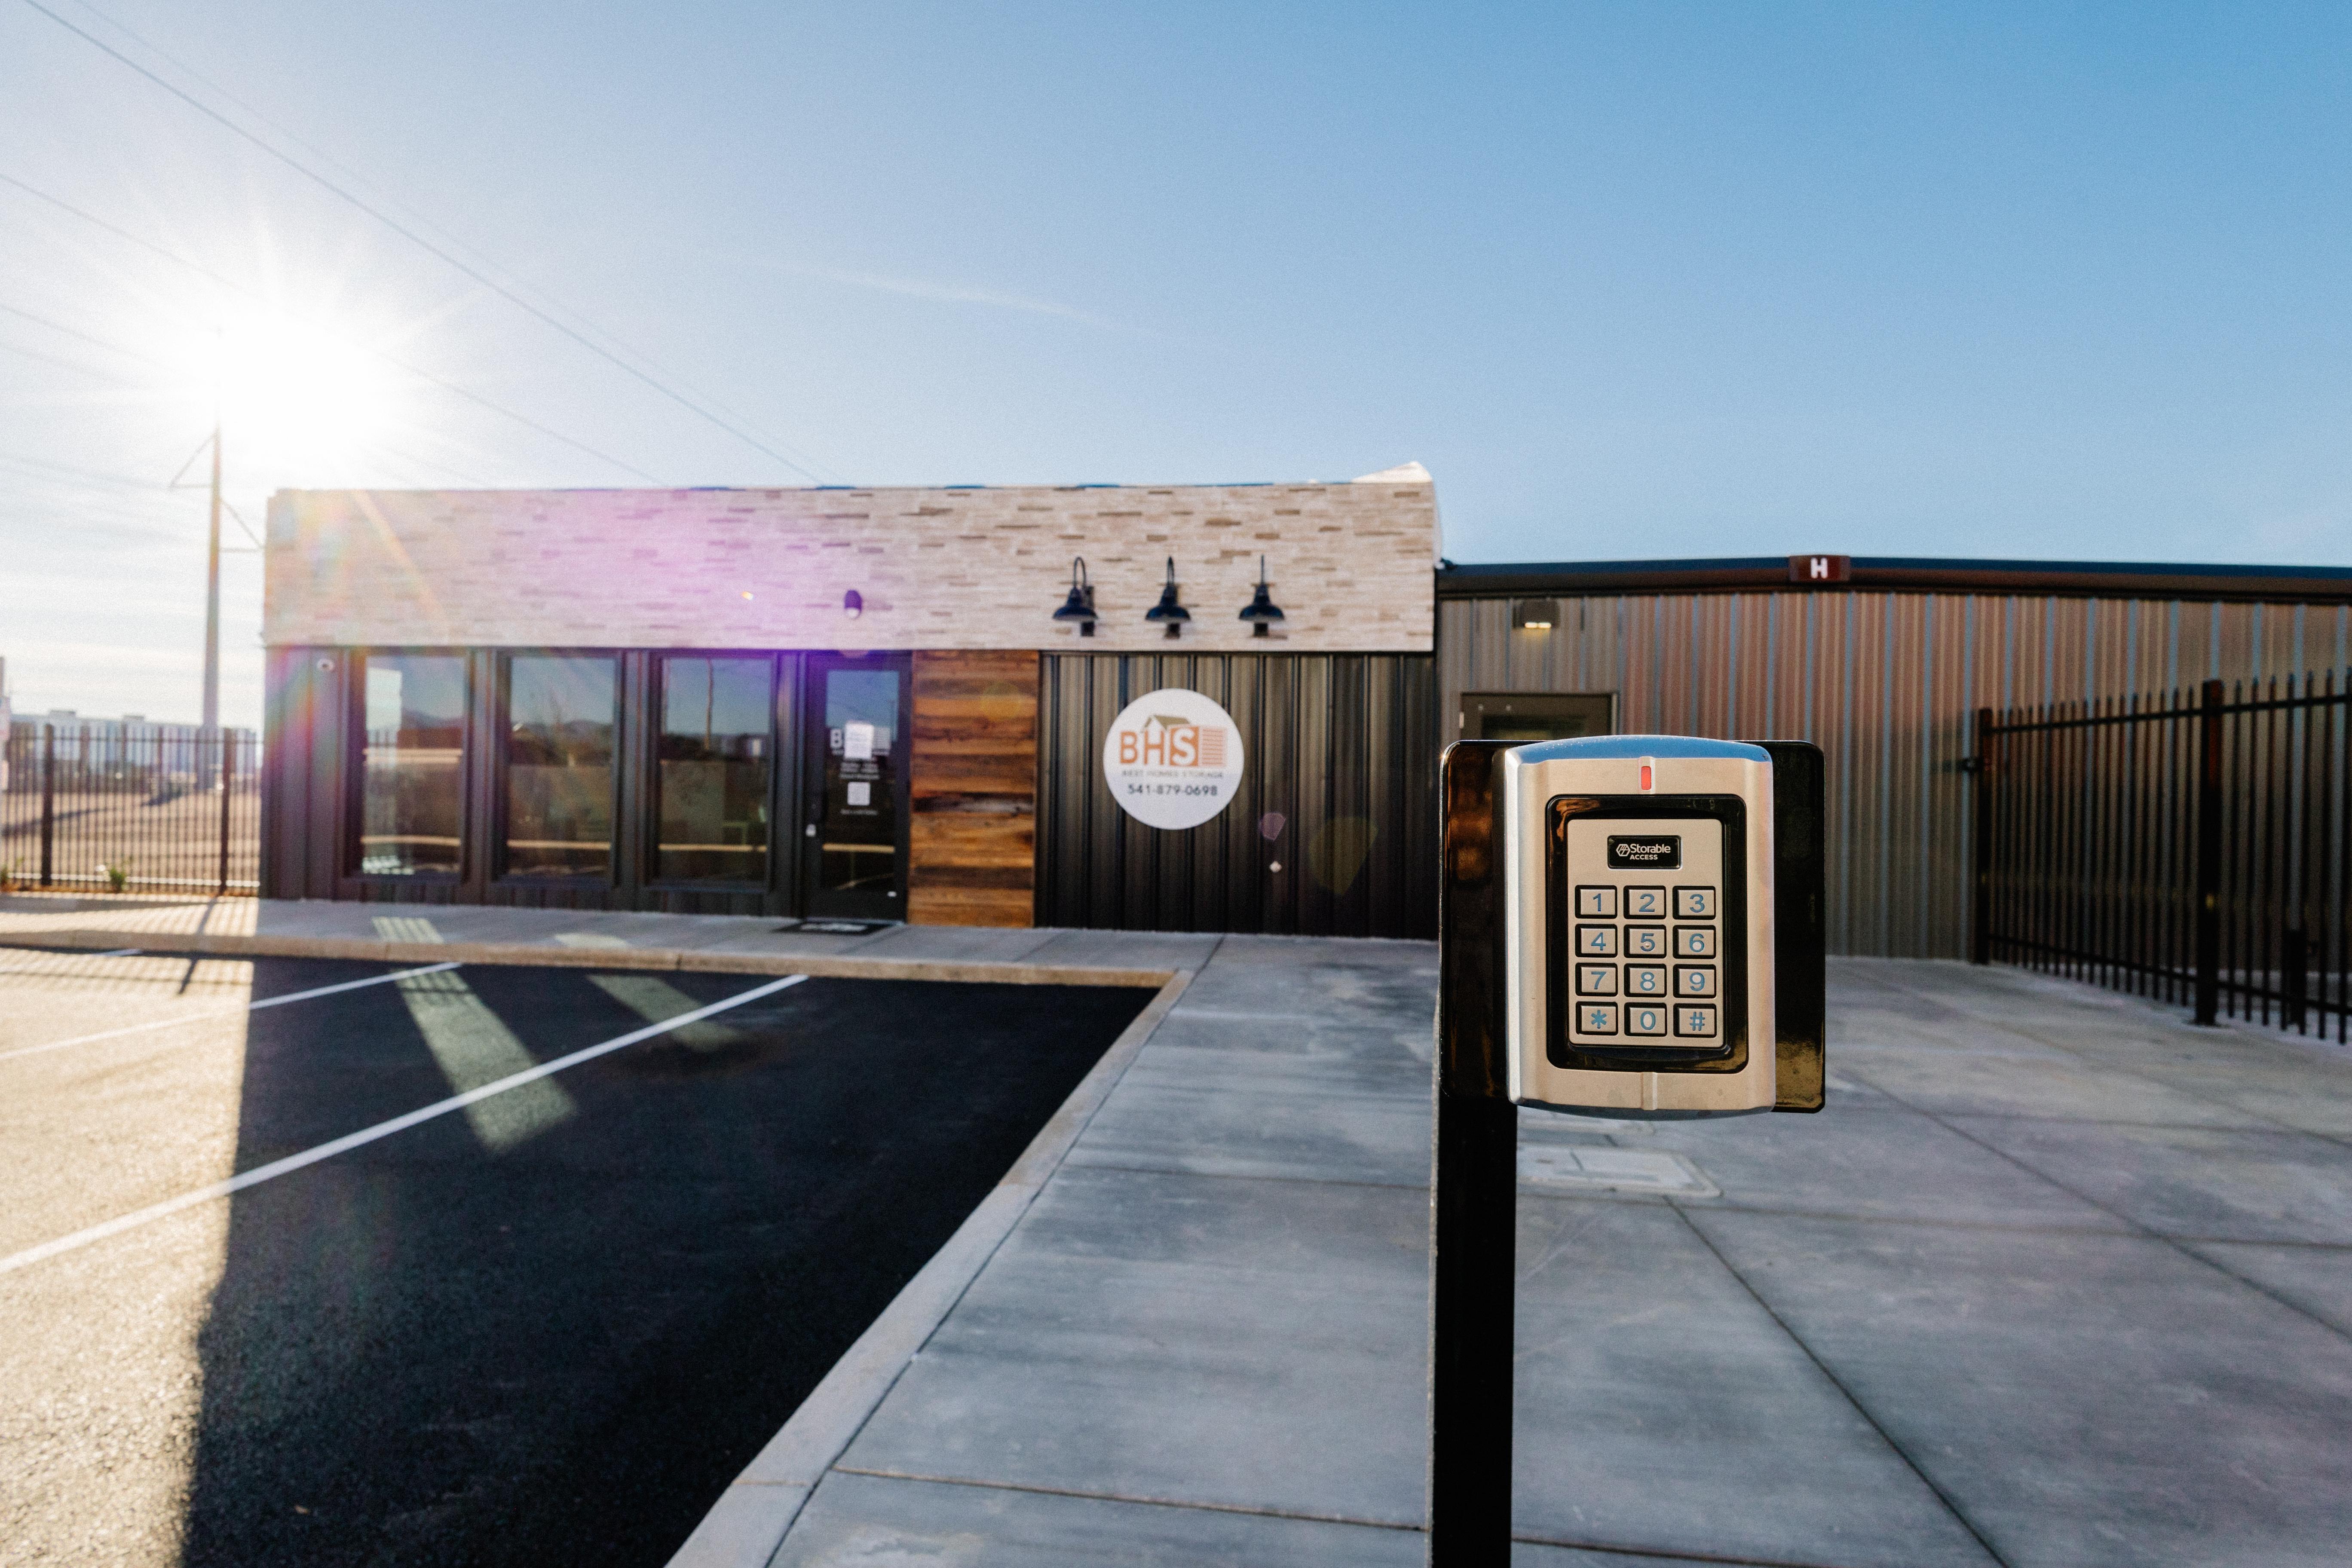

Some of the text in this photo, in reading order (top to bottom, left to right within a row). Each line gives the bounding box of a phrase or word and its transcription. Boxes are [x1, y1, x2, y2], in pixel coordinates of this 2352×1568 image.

[1810, 557, 1828, 579] H
[1120, 726, 1199, 766] BHS
[1128, 784, 1217, 795] 541-879-0698
[1630, 844, 1671, 853] Storable
[1592, 894, 1705, 913] 1 2 3
[1591, 933, 1705, 952] 4 5 6
[1592, 971, 1705, 991] 7 8 9
[1640, 1011, 1656, 1030] 0
[1690, 1012, 1705, 1031] #
